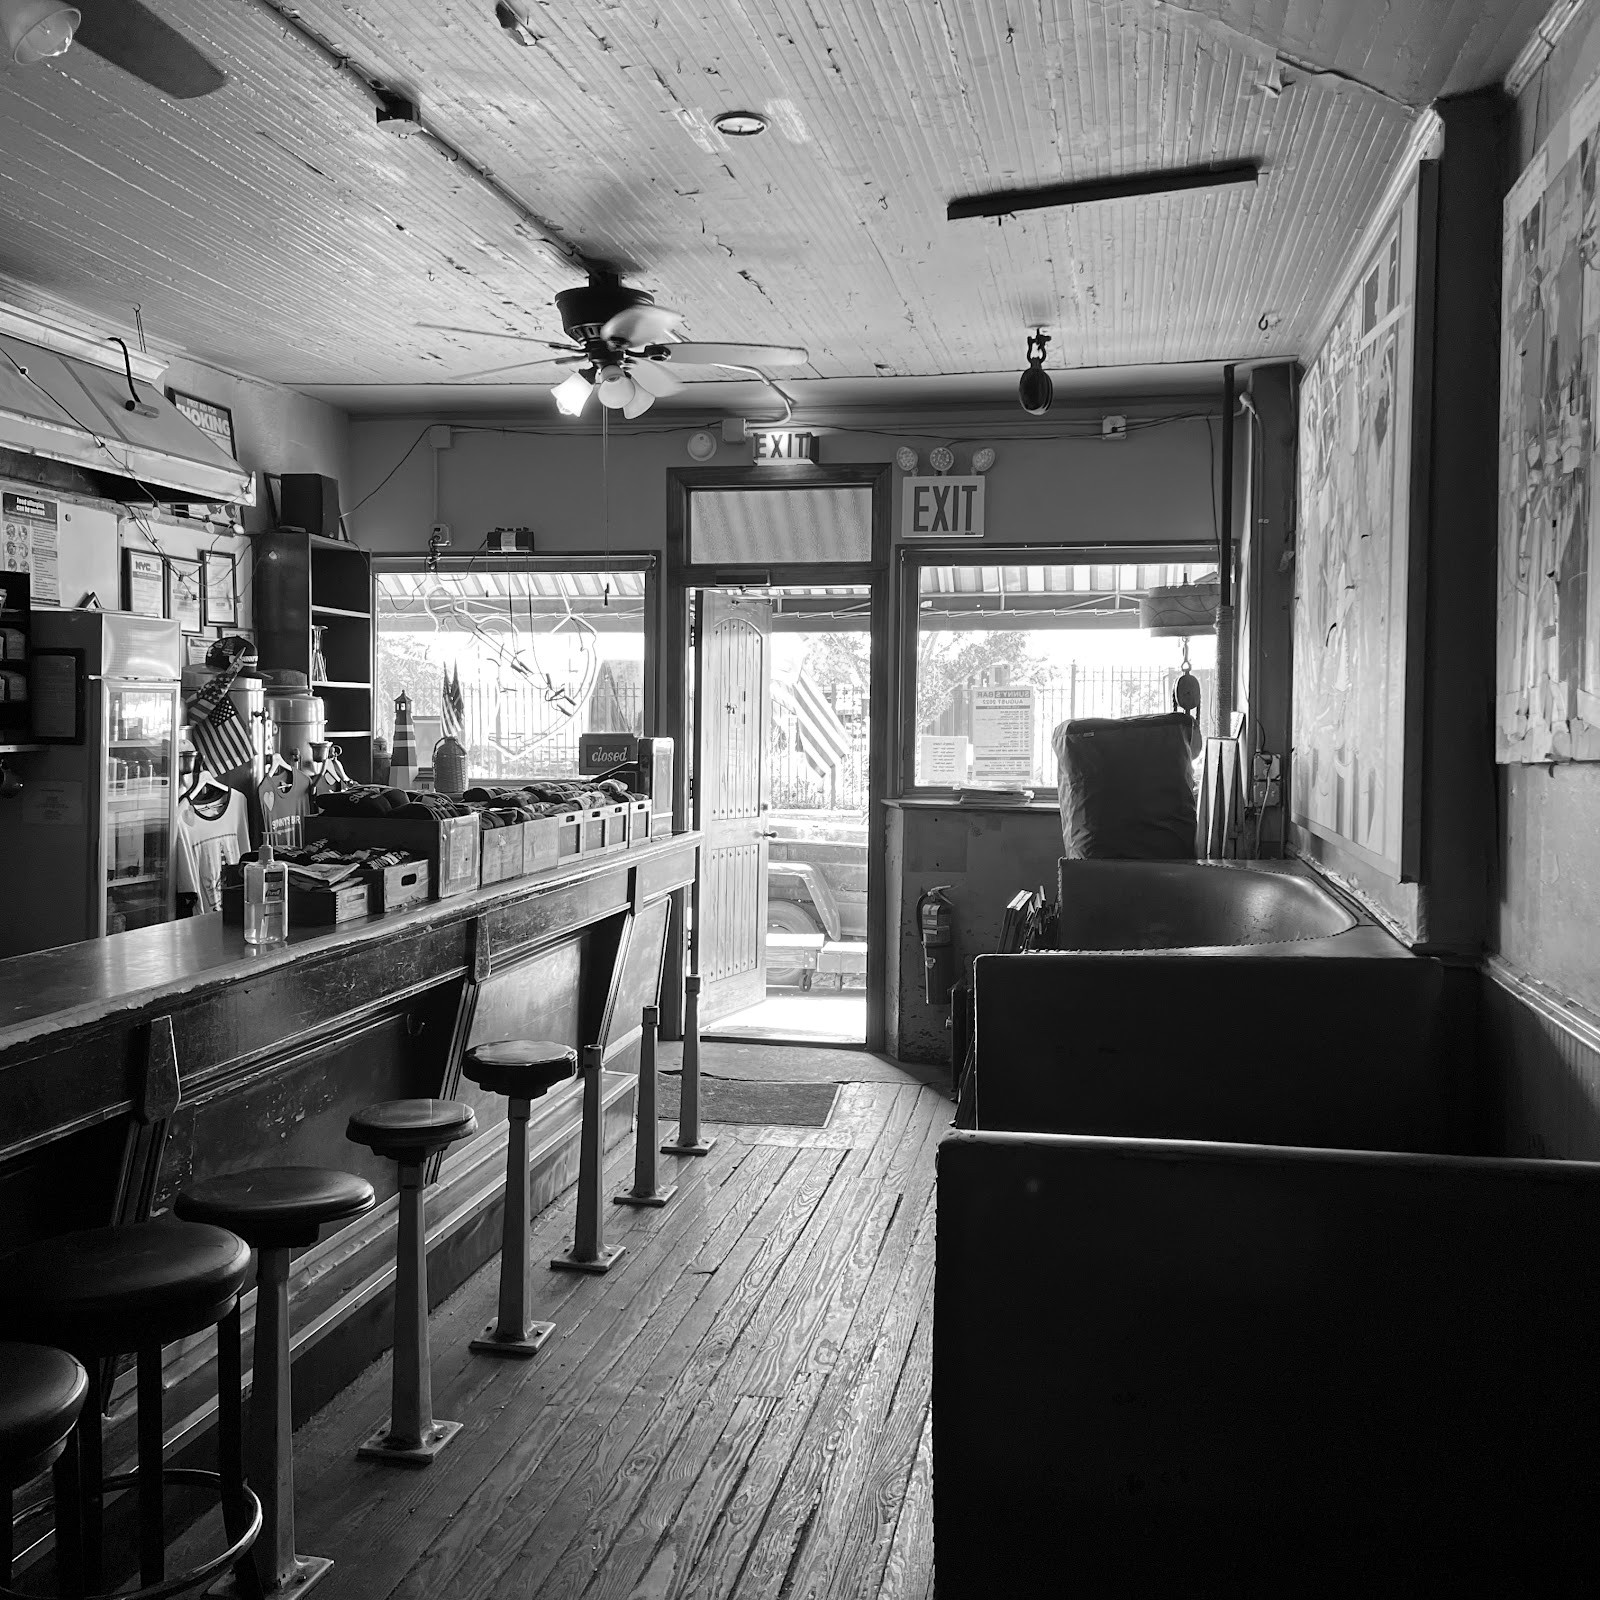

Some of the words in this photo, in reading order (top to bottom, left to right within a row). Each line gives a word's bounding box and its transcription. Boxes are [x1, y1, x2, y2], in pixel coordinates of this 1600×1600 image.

[756, 433, 808, 458] EXIT
[913, 485, 977, 532] EXIT
[135, 560, 151, 572] NYC
[591, 746, 628, 762] closed
